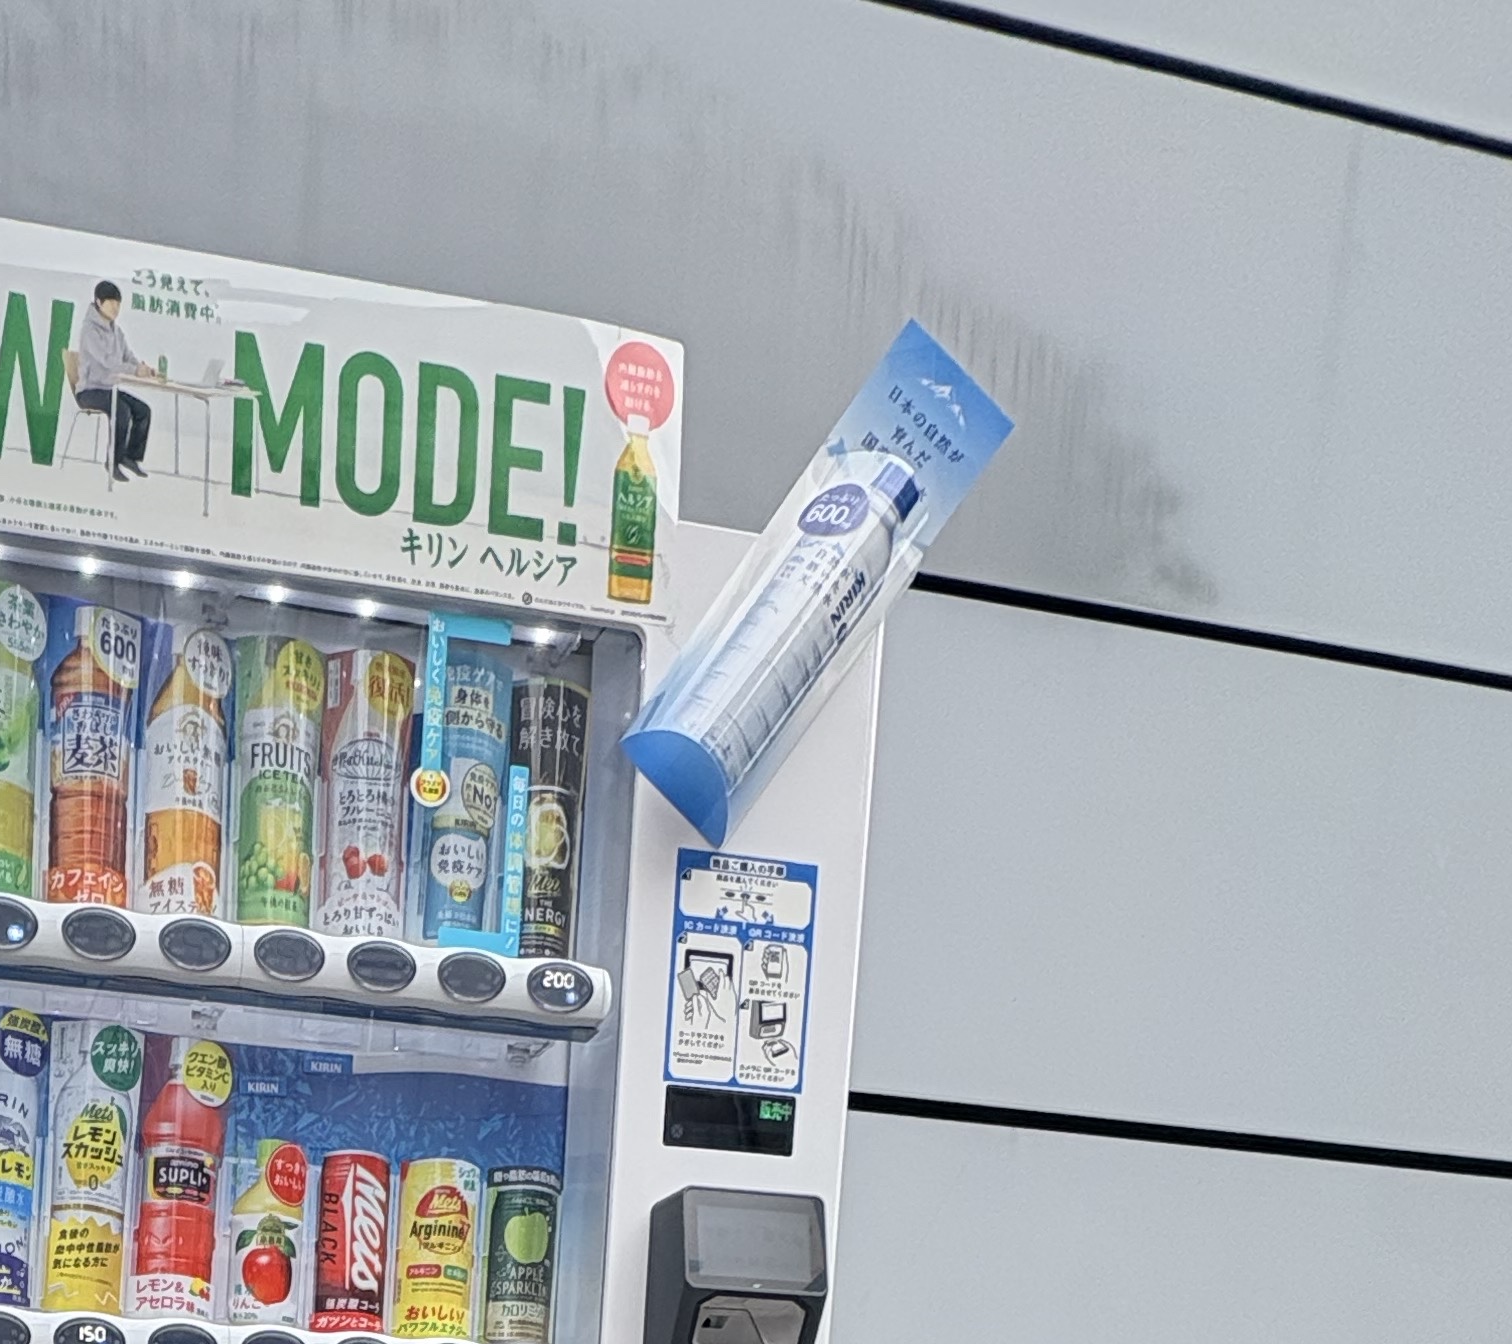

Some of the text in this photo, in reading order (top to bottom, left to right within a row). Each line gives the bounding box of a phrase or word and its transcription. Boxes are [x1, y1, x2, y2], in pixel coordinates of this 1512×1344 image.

[889, 385, 965, 464] 日本の自然が
[231, 330, 586, 547] MODE!
[401, 528, 468, 569] キリン
[480, 545, 578, 588] ヘルシア
[830, 571, 866, 628] KIRIN
[66, 733, 118, 772] 麦茶
[250, 742, 314, 779] FRUITS
[258, 769, 281, 781] ICE
[51, 869, 125, 893] カフェイン
[148, 876, 185, 901] 無糖
[543, 970, 575, 990] 200
[2, 1035, 43, 1068] 無糖
[184, 1064, 231, 1086] ビタミンC
[310, 1058, 343, 1076] KIRIN
[201, 1078, 219, 1095] 入り
[246, 1080, 280, 1096] KIRIN
[80, 1103, 115, 1123] Mets
[72, 1125, 118, 1147] レモン
[61, 1142, 125, 1169] スカッシュ
[58, 1227, 90, 1241] 食後の
[322, 1191, 340, 1267] BLACK
[350, 1162, 387, 1296] Mets
[409, 1219, 466, 1241] Arginine
[52, 1257, 110, 1271] 気になる方に
[509, 1266, 545, 1282] APPLE
[136, 1279, 185, 1295] レモン&
[135, 1293, 195, 1315] アセロラ味
[405, 1304, 466, 1325] おいしい!
[78, 1326, 107, 1343] 150
